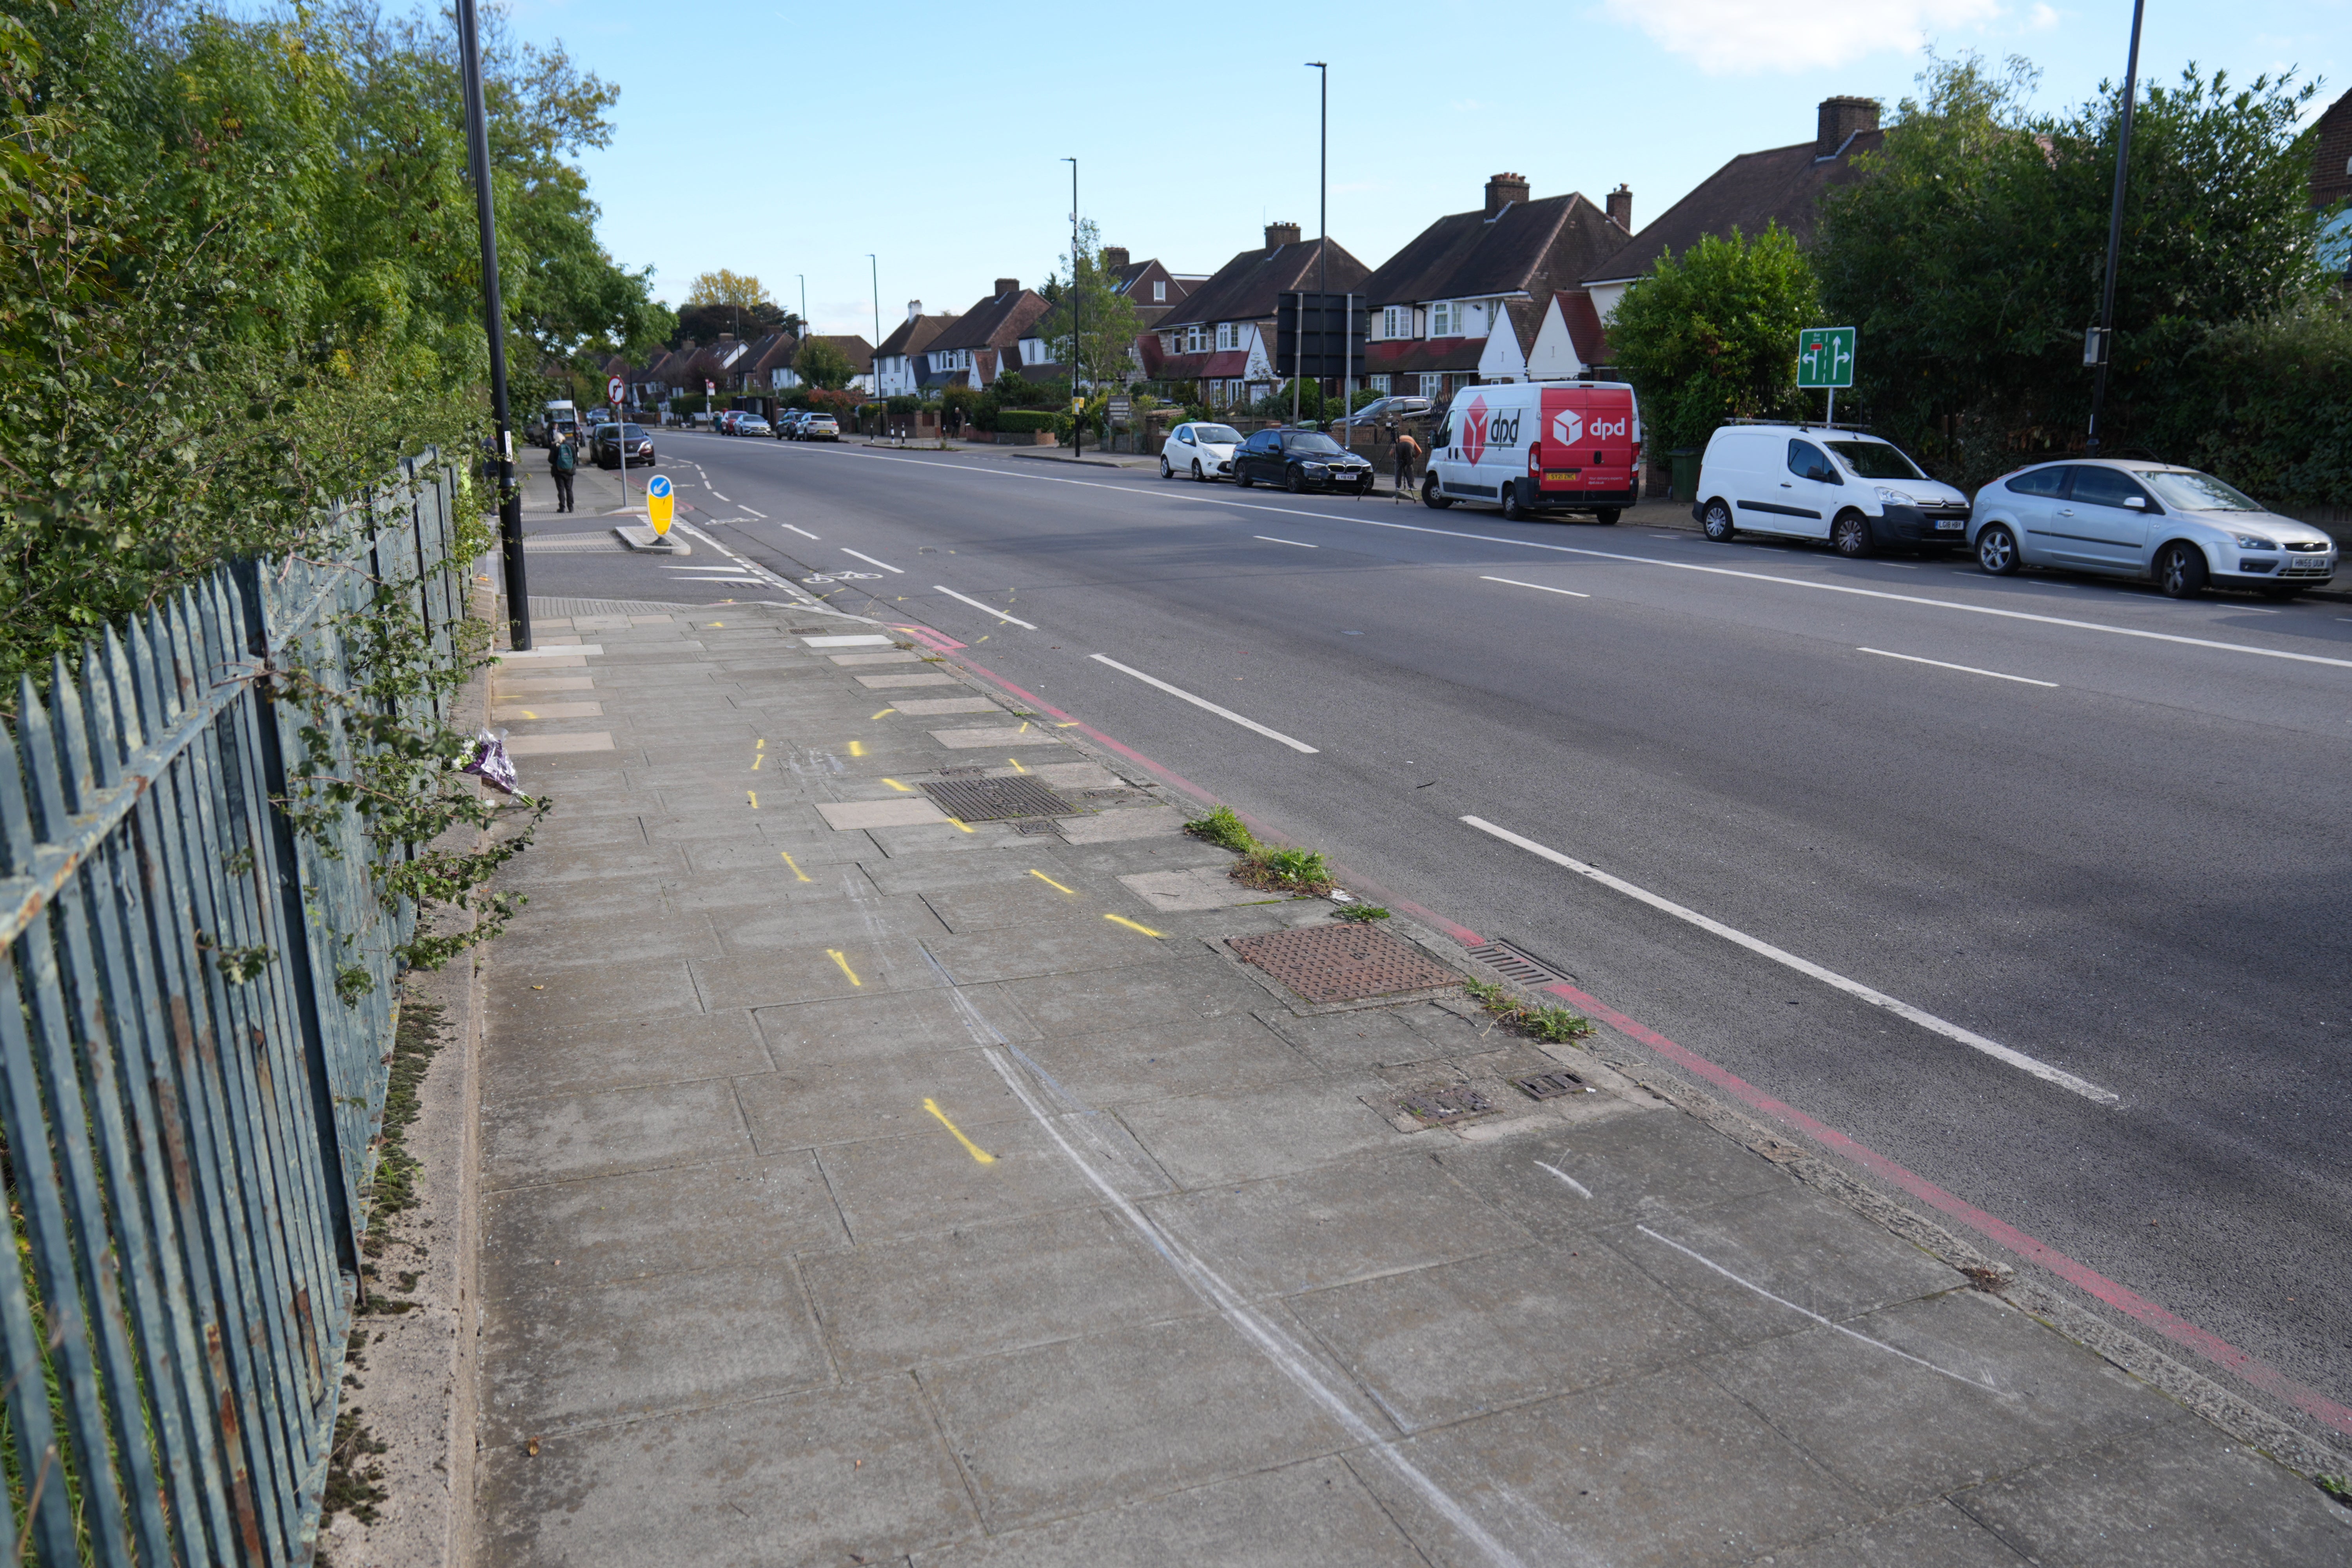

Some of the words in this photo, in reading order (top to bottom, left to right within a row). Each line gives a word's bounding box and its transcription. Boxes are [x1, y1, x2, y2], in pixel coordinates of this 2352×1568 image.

[1491, 408, 1521, 451] dpd
[1590, 417, 1625, 440] dpd
[2296, 559, 2312, 567] HN55
